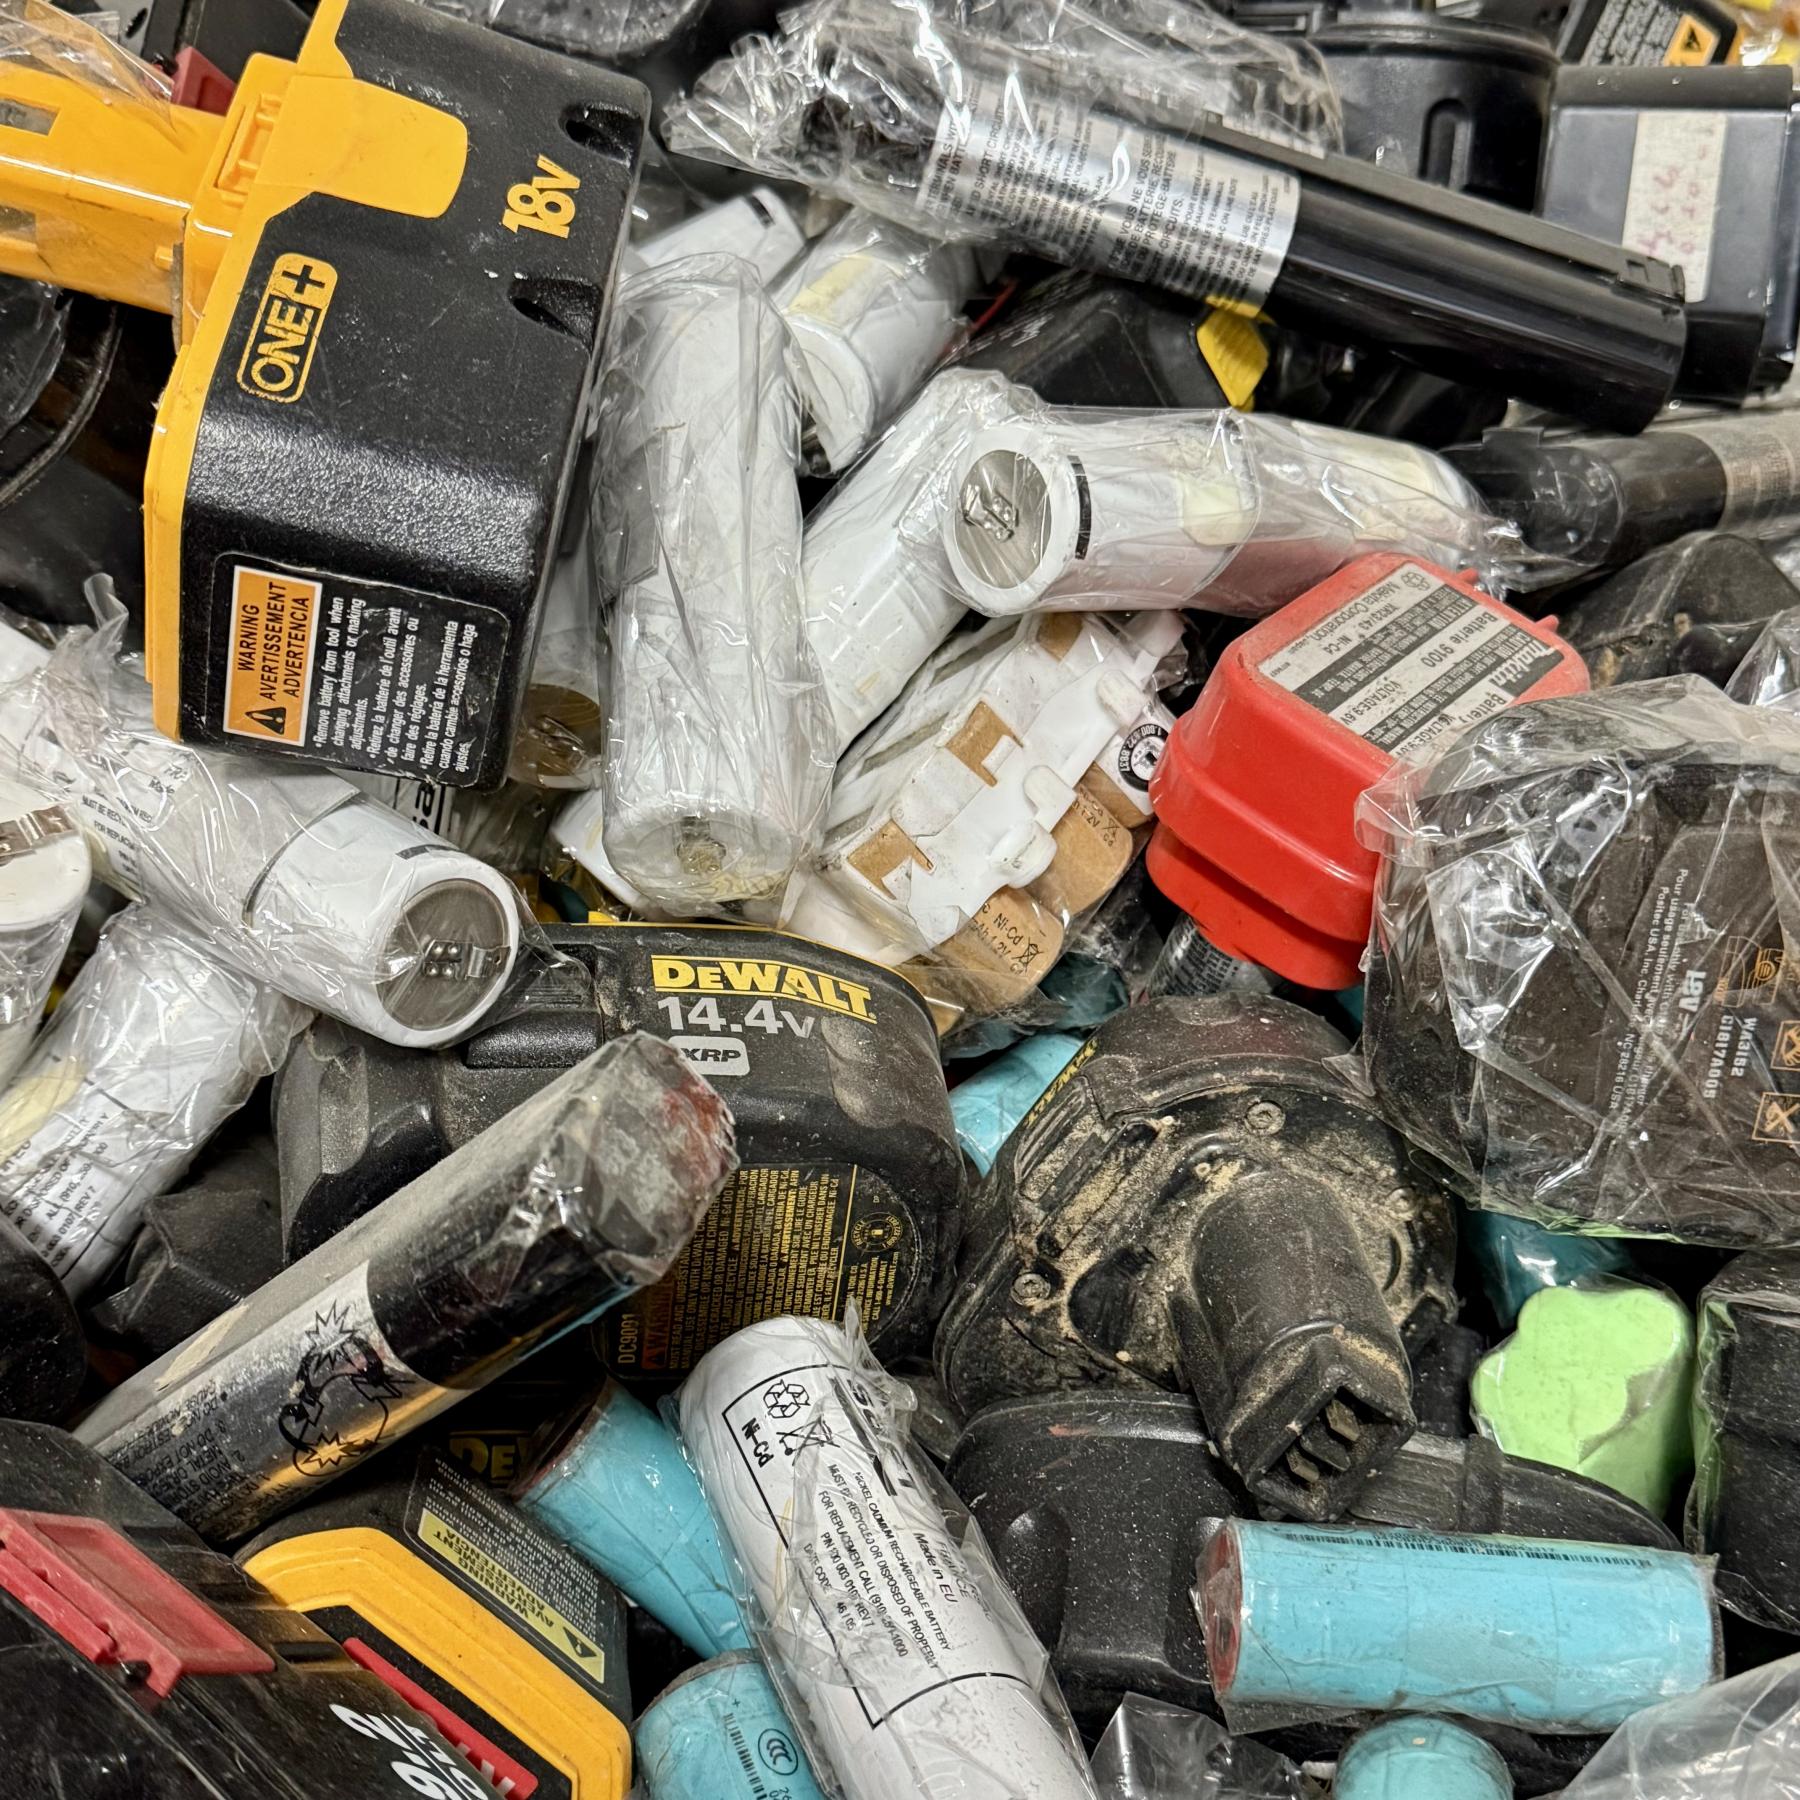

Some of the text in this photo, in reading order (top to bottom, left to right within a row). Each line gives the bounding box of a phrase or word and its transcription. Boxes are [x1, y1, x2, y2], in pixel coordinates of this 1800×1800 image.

[329, 596, 344, 623] when
[384, 606, 402, 635] avant
[236, 603, 260, 672] WARNING
[258, 580, 286, 701] AVERTISSEMENT
[323, 626, 340, 646] tool
[459, 623, 479, 648] haga
[1449, 607, 1496, 649] Batterie
[282, 596, 309, 697] ADVERTENCIA
[321, 649, 338, 672] from
[379, 636, 397, 664] l'outil
[435, 619, 459, 676] herramienta
[1419, 639, 1454, 671] 9100
[330, 597, 366, 747] changing attachments or making
[378, 665, 392, 676] de
[383, 617, 419, 757] de changer des accessoires ou
[433, 676, 448, 685] la
[449, 657, 469, 705] accesorios
[318, 673, 338, 707] battery
[372, 677, 391, 712] batterie
[431, 686, 447, 699] de
[348, 696, 370, 750] adjustments.
[371, 713, 386, 723] la
[400, 681, 429, 761] faire des réglages.
[424, 730, 438, 739] la
[442, 705, 459, 737] cambie
[437, 738, 454, 768] cuando
[1671, 867, 1688, 897] Pour
[1650, 885, 1669, 926] Positec
[1661, 896, 1679, 932] usage
[991, 911, 1025, 946] Ni-Cd
[1648, 933, 1671, 994] seulement
[679, 1047, 741, 1063] XRP
[1622, 1032, 1634, 1051] NC
[1608, 1084, 1623, 1110] USA
[738, 1169, 749, 1184] POR
[756, 1167, 769, 1205] CARGADOR
[766, 1169, 779, 1206] CARGADOR
[723, 1189, 733, 1201] DO
[777, 1189, 786, 1199] DE
[780, 1168, 800, 1254] AVERTISSEMENT: AFIN
[742, 1208, 754, 1236] PARA LA
[796, 1179, 819, 1288] SEULEMENT AVEC UN CHARGEUR
[809, 1249, 819, 1264] PILE
[817, 1185, 828, 1205] DANS
[783, 1184, 808, 1310] FONCTIONNEMENT LIRE LE GUIDE
[701, 1238, 716, 1293] OR INSERT IN
[713, 1272, 725, 1285] OR
[813, 1250, 829, 1305] EST OU
[847, 1274, 856, 1289] TOOL
[686, 1267, 701, 1313] ONLY WITH
[824, 1278, 834, 1296] FAUT
[709, 1286, 723, 1323] CRACKED
[862, 1297, 873, 1322] SERVICE
[871, 1305, 881, 1320] CALL
[616, 1312, 642, 1364] DC9091
[170, 1439, 199, 1464] NOT
[739, 1416, 775, 1469] Ni-Cd
[196, 1456, 233, 1487] AVOID
[826, 1462, 847, 1489] MUST
[817, 1489, 889, 1618] FOR REPLACEMENT CALL (910)
[851, 1470, 952, 1652] NICKEL CADMIUM RECHARGEABLE BATTERY
[868, 1543, 883, 1560] OR
[912, 1529, 958, 1606] Made in EU
[431, 1528, 555, 1628] AVERTISSEMENT
[442, 1527, 546, 1611] ADVERTENCIA
[874, 1558, 907, 1606] DISPOSED
[454, 1555, 532, 1618] WARNING
[853, 1600, 872, 1623] REV
[863, 1619, 874, 1629] 7
[899, 1603, 914, 1620] OF
